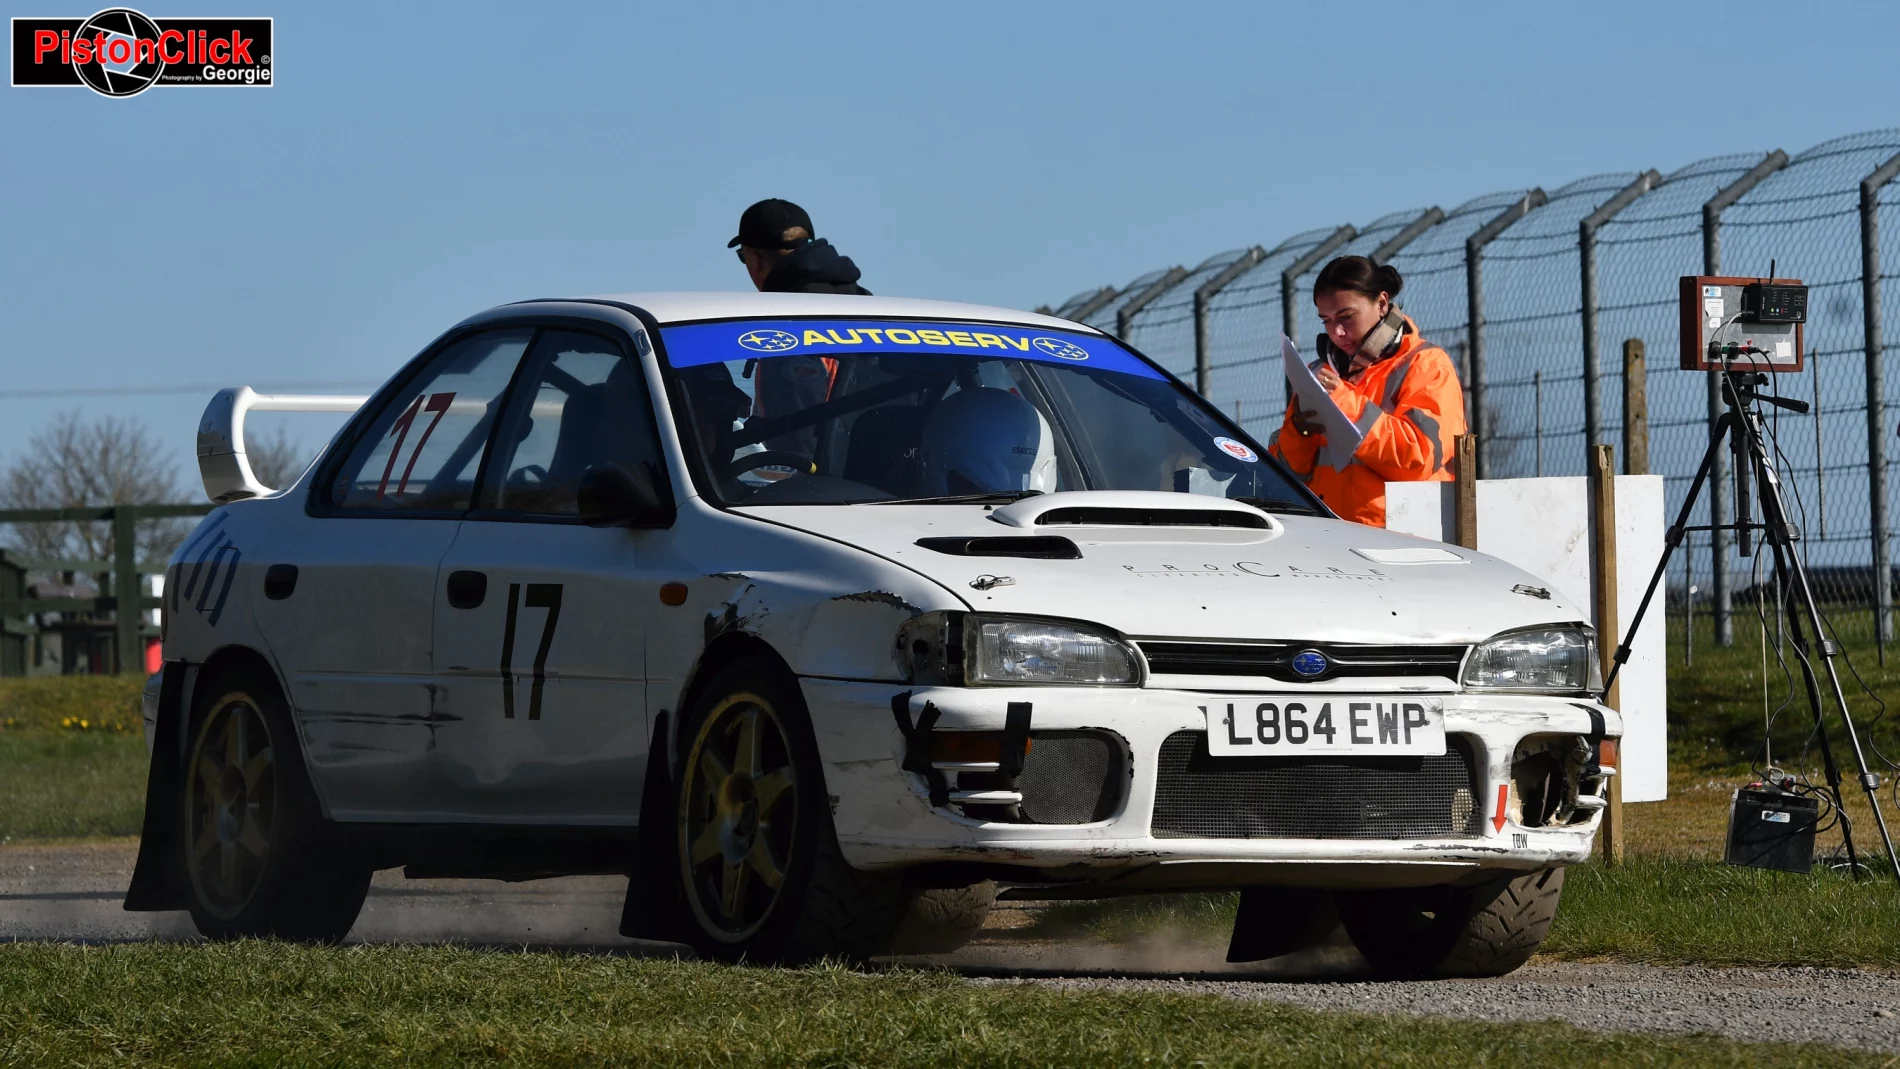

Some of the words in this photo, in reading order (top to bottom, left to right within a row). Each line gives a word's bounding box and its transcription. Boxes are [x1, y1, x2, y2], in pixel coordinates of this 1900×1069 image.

[804, 328, 1029, 352] AUTOSERV
[376, 391, 457, 500] 17
[500, 583, 564, 720] 17
[1226, 702, 1336, 745] L864
[1348, 702, 1427, 745] EWP
[1512, 833, 1528, 849] TOW
